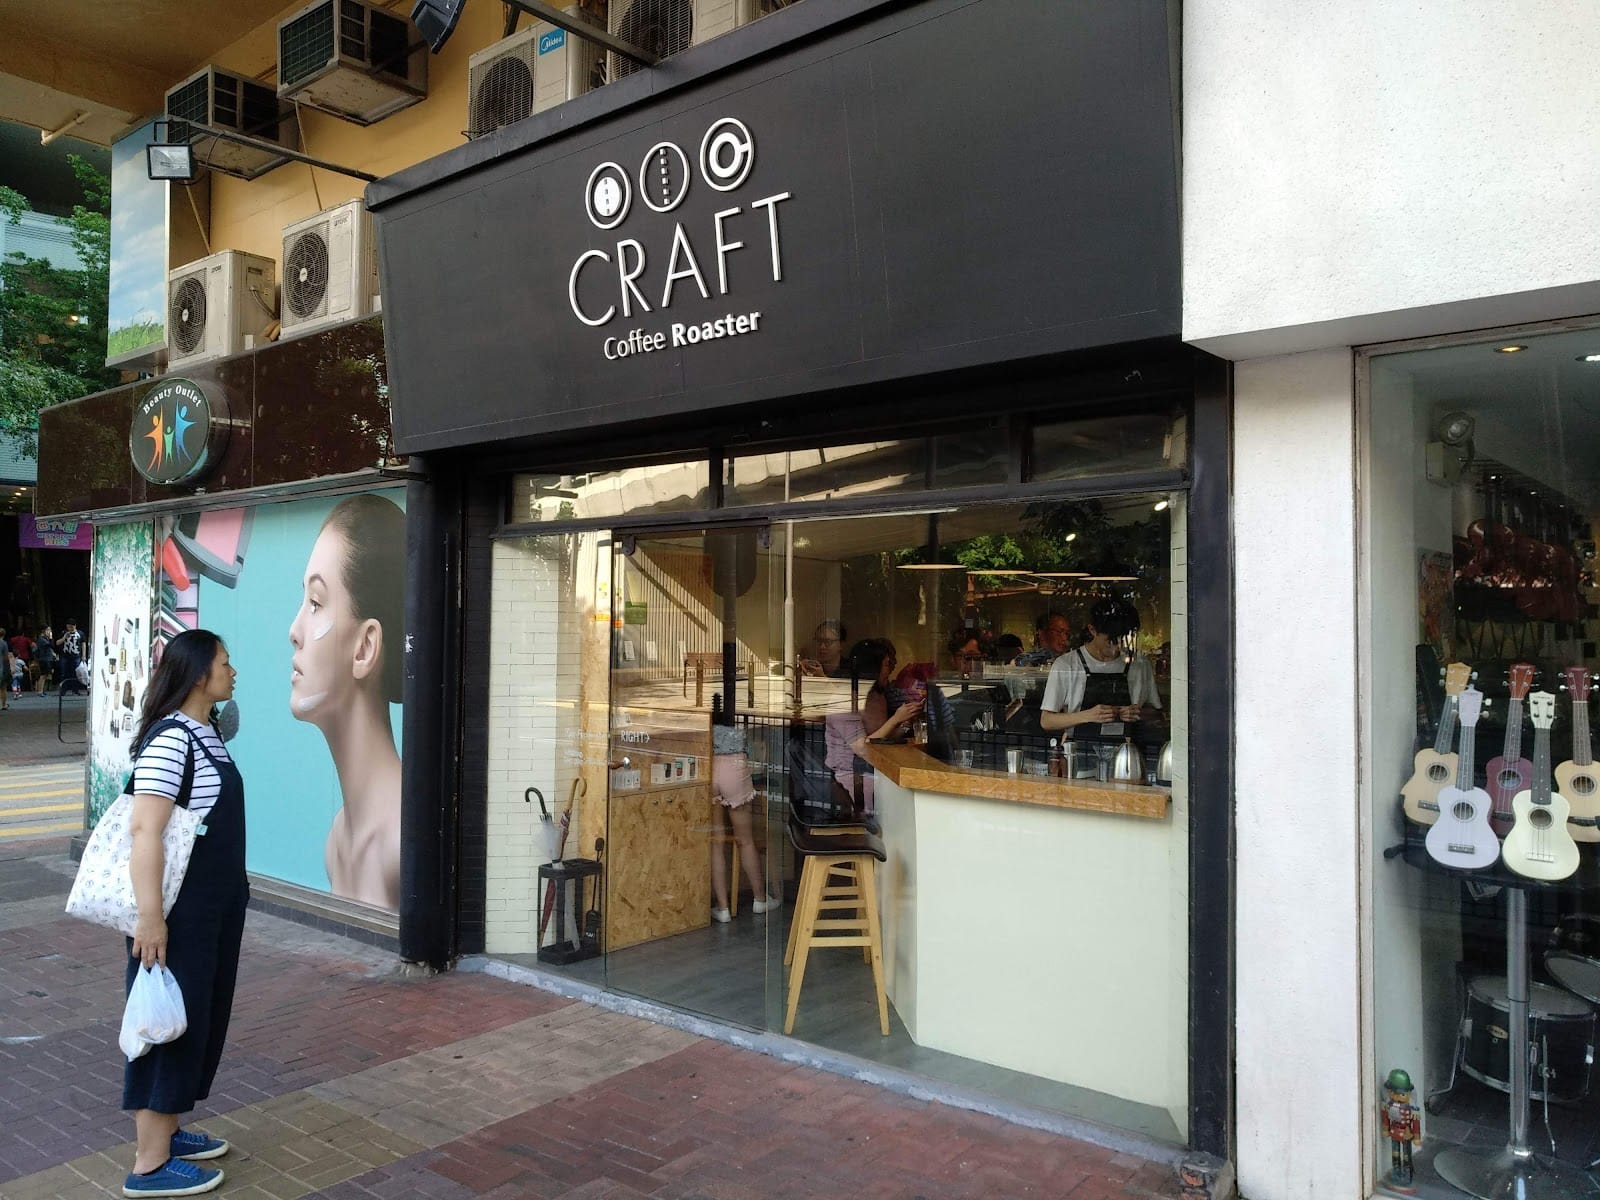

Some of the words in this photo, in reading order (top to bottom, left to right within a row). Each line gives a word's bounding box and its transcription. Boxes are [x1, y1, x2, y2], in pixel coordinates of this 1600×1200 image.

[542, 36, 562, 51] Midea
[568, 191, 791, 326] CRAFT
[604, 328, 666, 360] Coffee
[671, 311, 762, 347] Roaster
[143, 388, 172, 415] Beauty
[175, 385, 202, 407] Outlet
